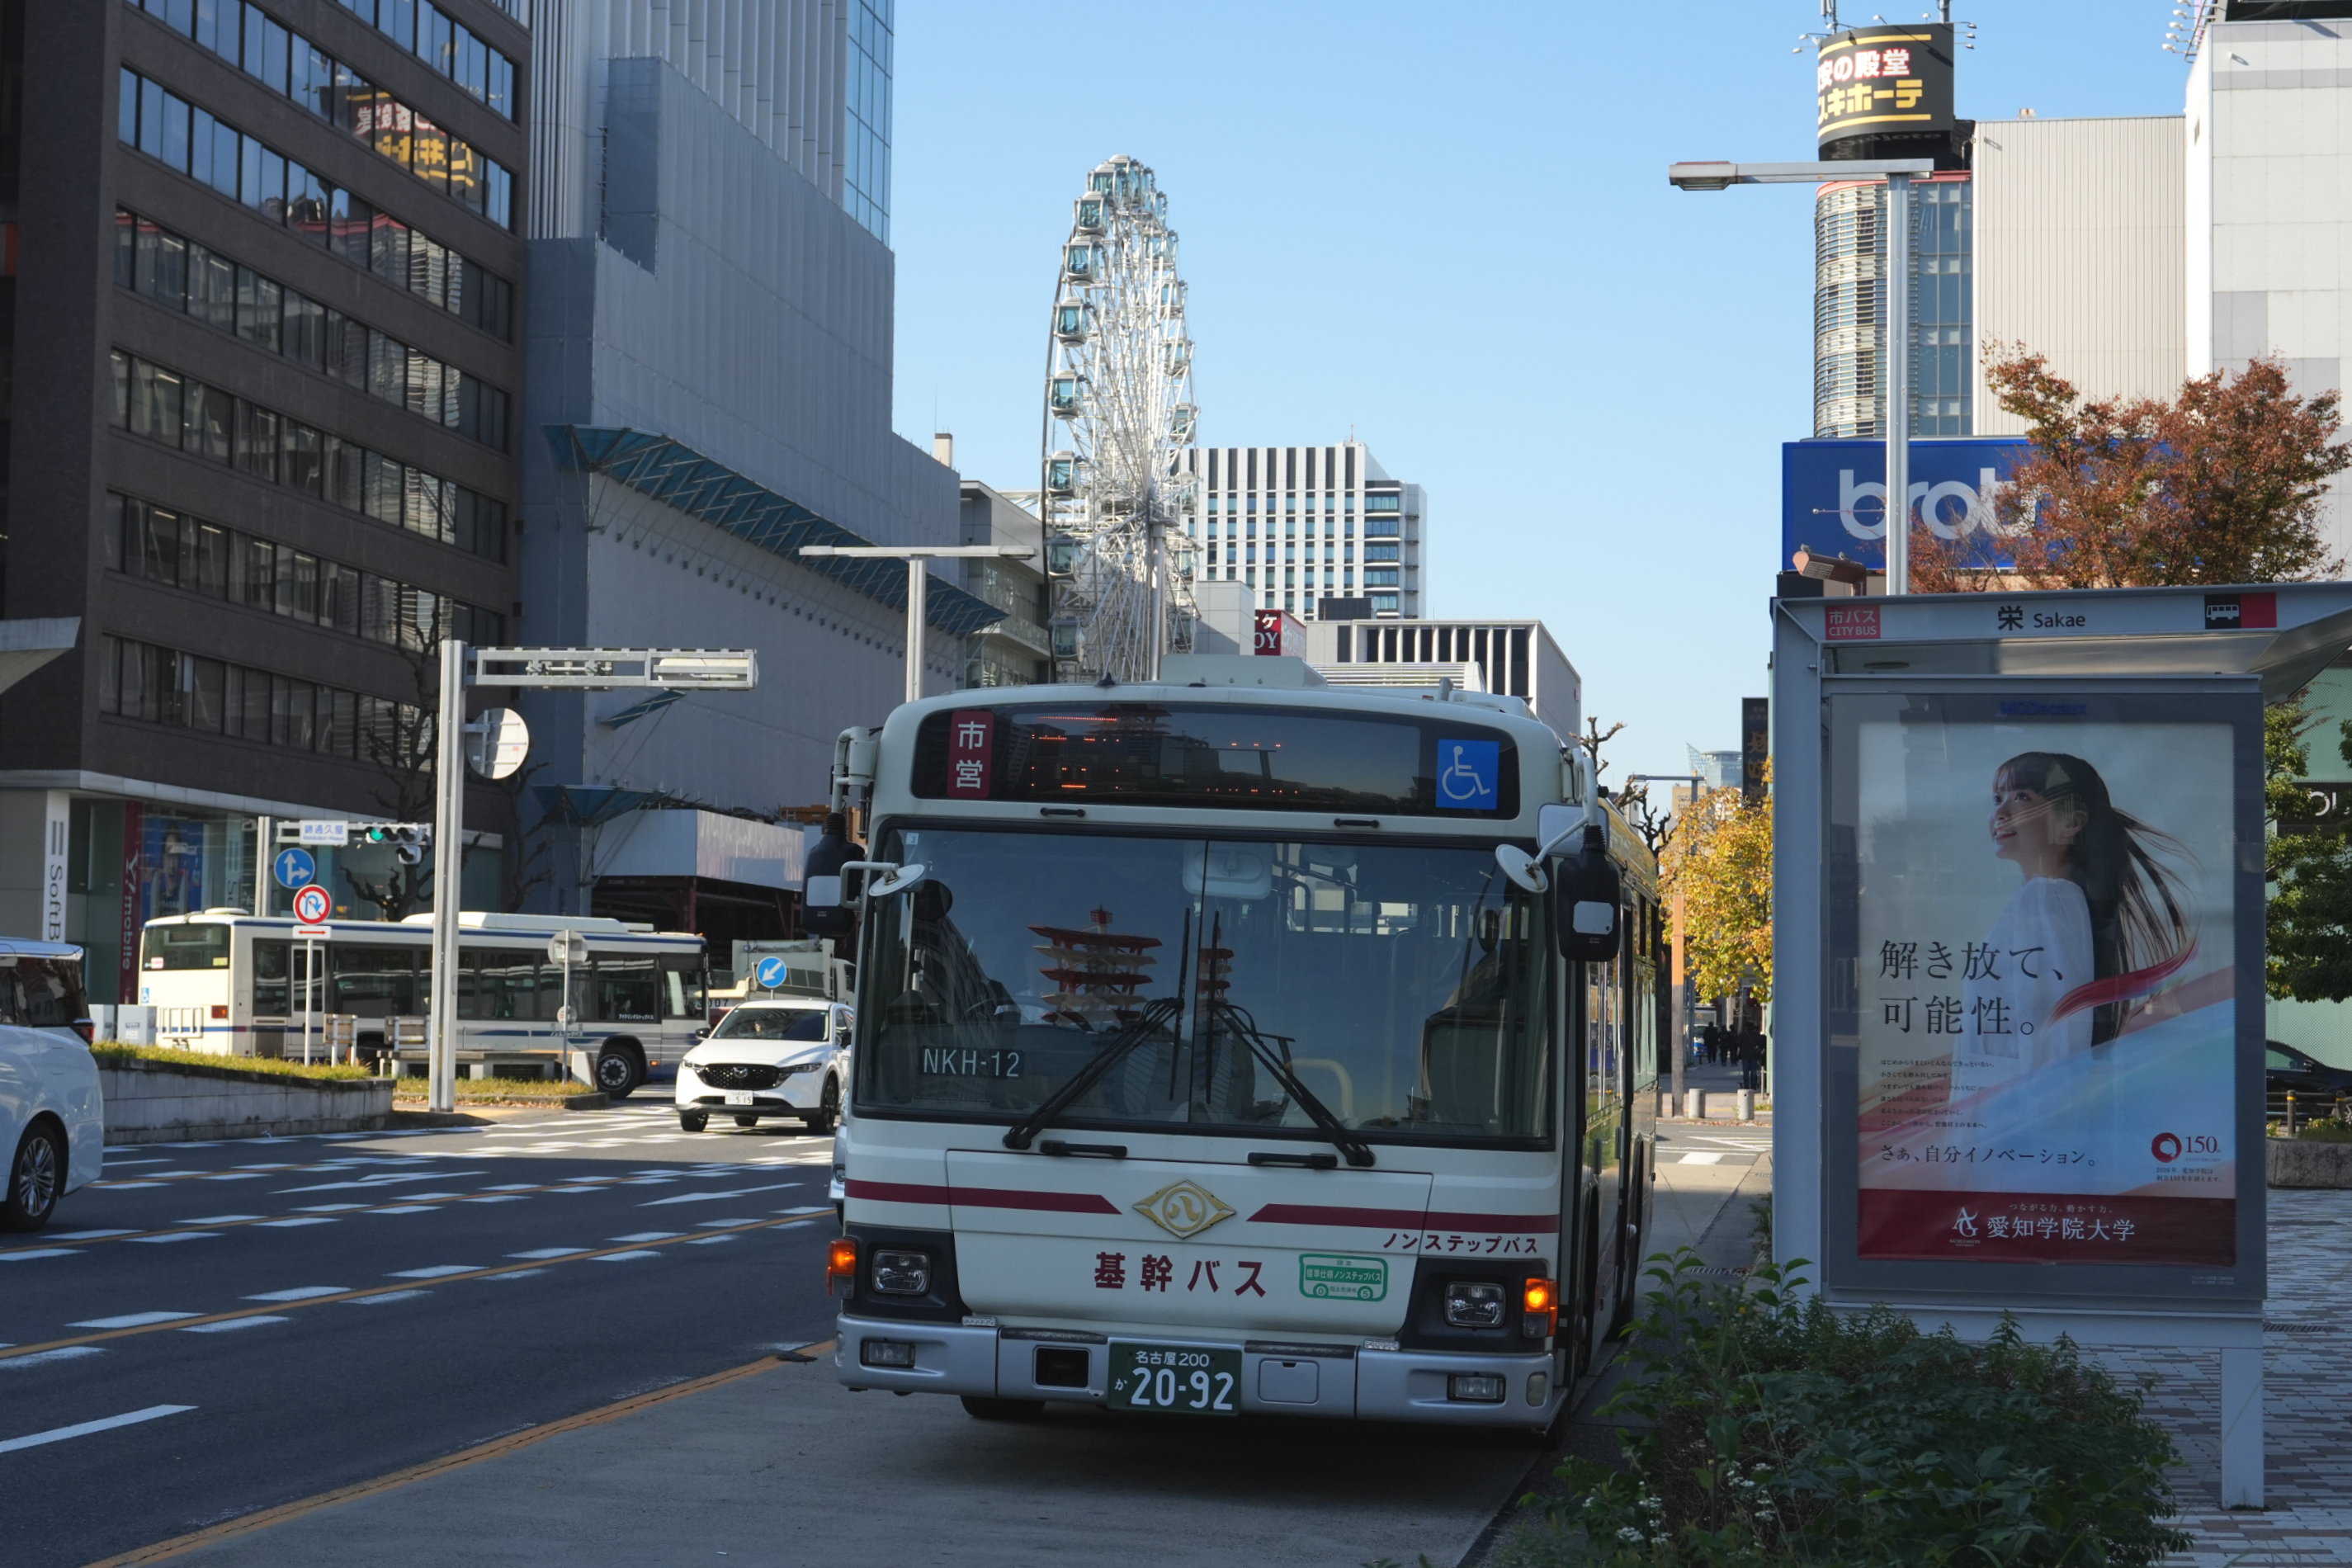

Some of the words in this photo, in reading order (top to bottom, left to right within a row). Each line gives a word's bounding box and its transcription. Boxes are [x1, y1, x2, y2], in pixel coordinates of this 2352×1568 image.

[1818, 48, 1910, 93] 安の殿堂
[1829, 610, 1876, 625] 市バス
[1829, 626, 1854, 636] CITY
[1856, 626, 1877, 635] BUS
[1997, 606, 2024, 631] 栄
[2033, 612, 2086, 628] Sakae
[2000, 701, 2088, 716] MCDecaux
[956, 720, 986, 789] 市営
[123, 848, 139, 970] Y!mobile
[1879, 940, 2062, 980] 解き放て、
[1879, 994, 2033, 1035] 可能性。
[923, 1048, 1020, 1077] NKH-12
[1987, 1216, 2136, 1241] 愛知学院大学
[1383, 1232, 1538, 1254] ノンステップバス
[1094, 1252, 1266, 1297] 基幹バス
[1306, 1268, 1381, 1282] 標準仕様ノンステップバス
[1114, 1378, 1128, 1391] か
[1131, 1367, 1234, 1410] 20-92
